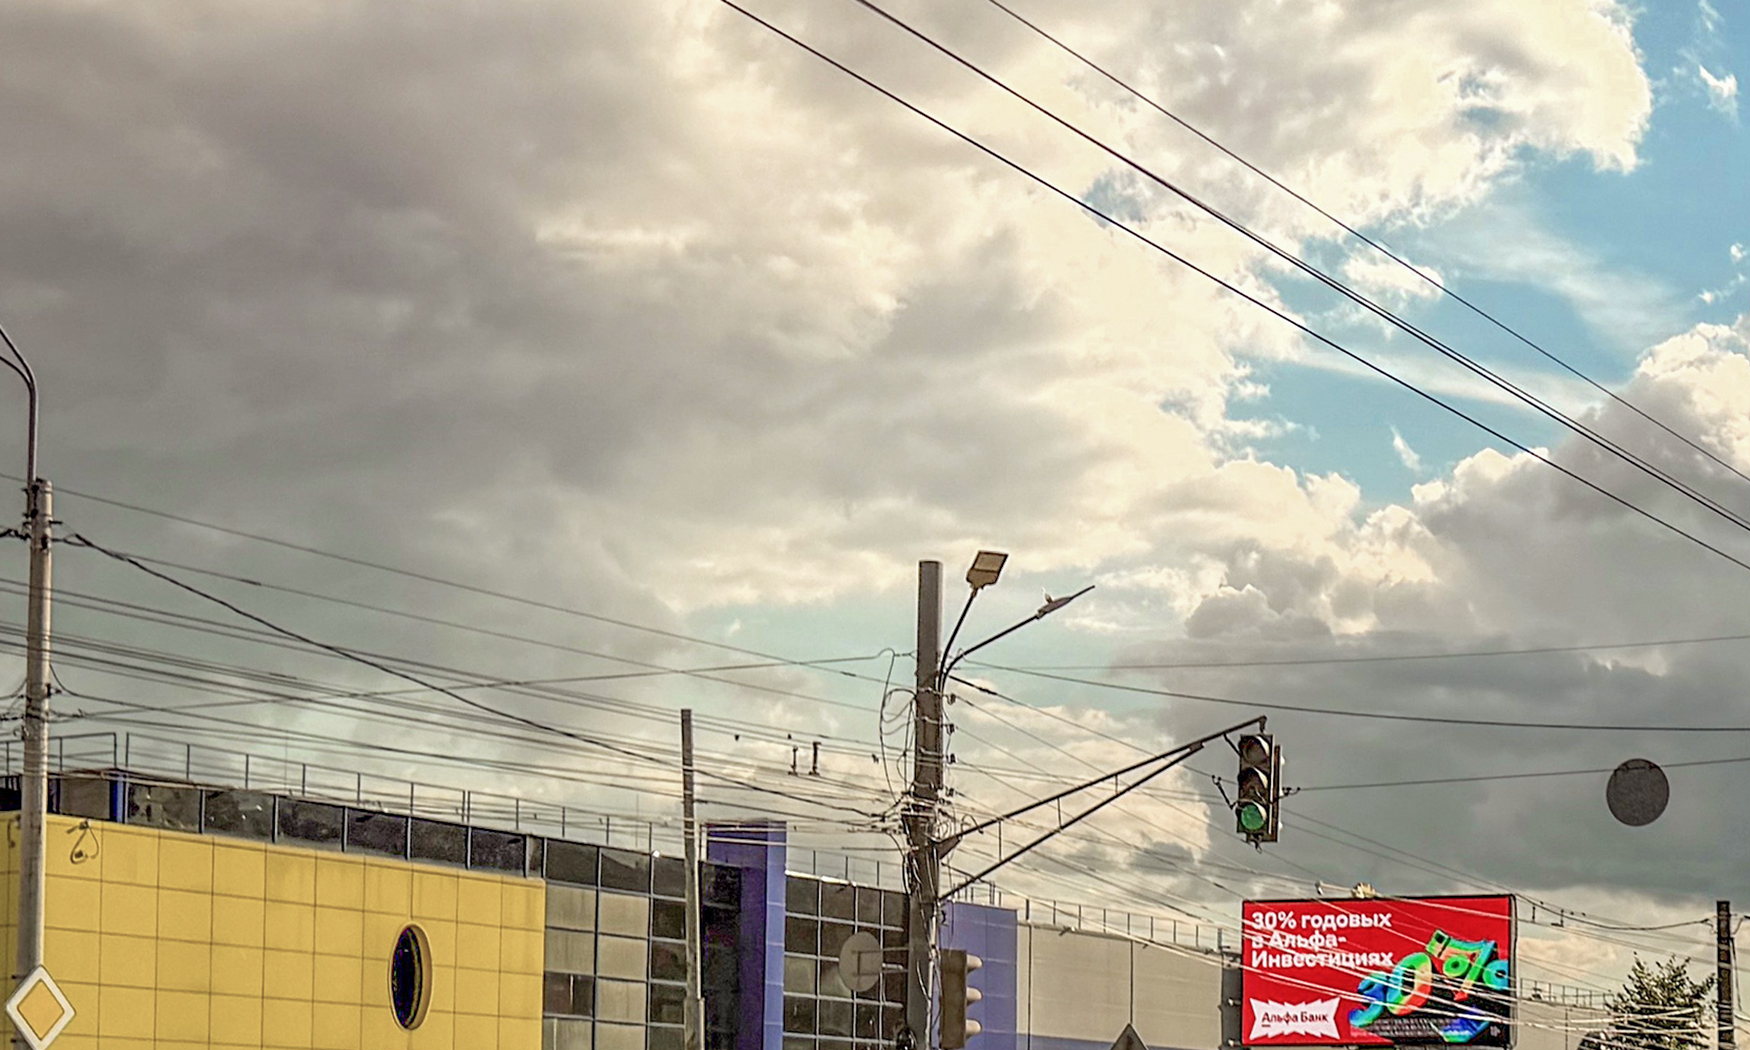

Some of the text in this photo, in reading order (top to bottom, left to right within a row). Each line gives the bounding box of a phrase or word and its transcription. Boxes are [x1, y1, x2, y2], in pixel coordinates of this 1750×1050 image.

[1252, 911, 1392, 931] 30% годовых
[1269, 930, 1347, 953] Альфа-
[1252, 950, 1394, 969] Инвестициях
[1261, 1011, 1329, 1026] Альфа Банк
